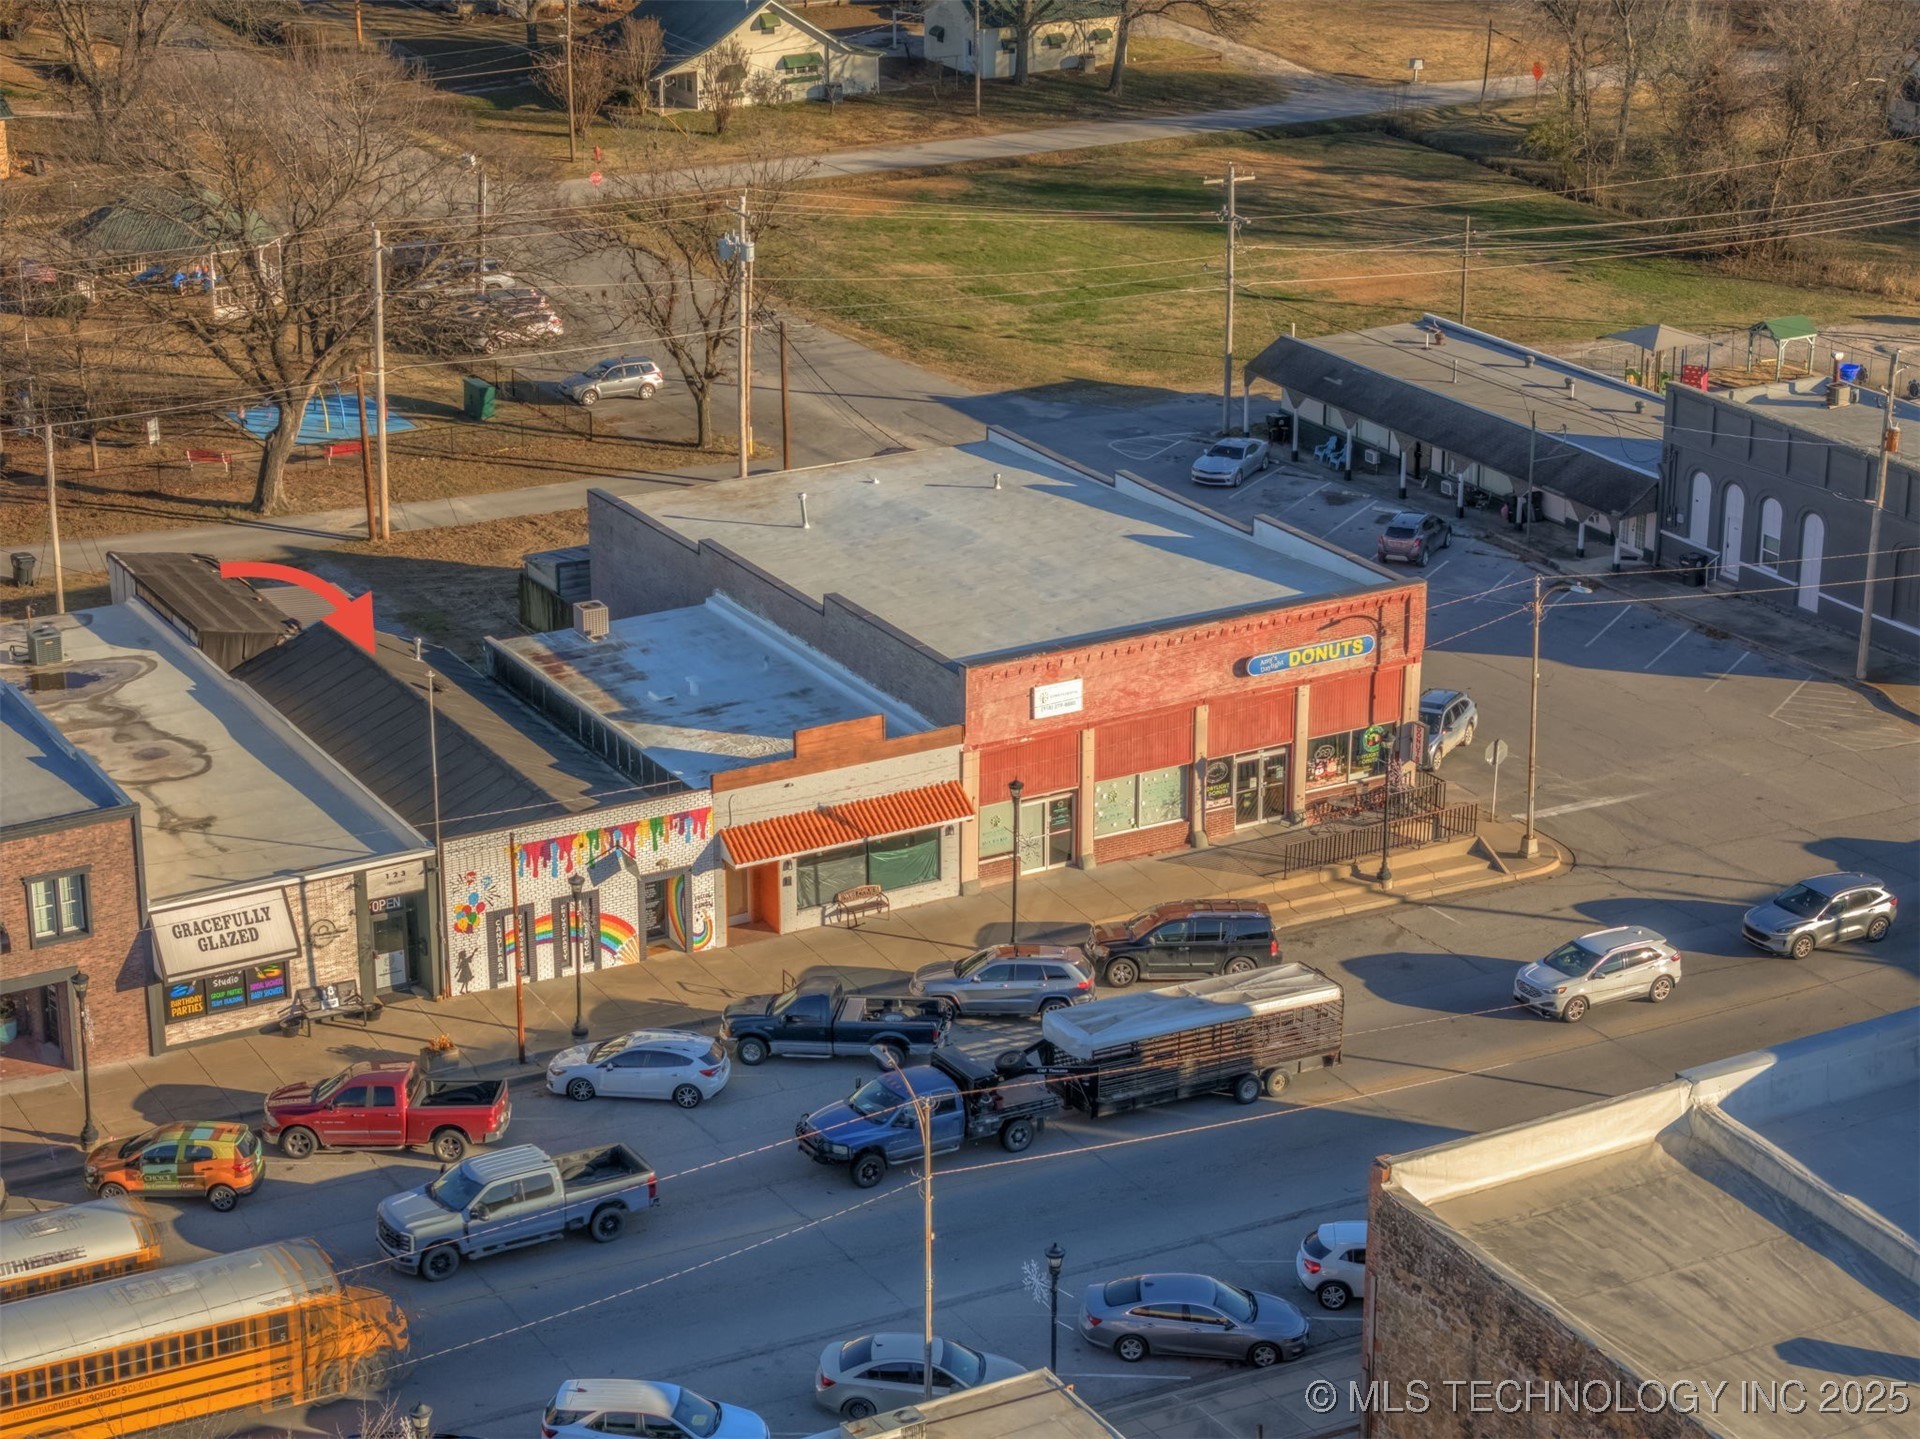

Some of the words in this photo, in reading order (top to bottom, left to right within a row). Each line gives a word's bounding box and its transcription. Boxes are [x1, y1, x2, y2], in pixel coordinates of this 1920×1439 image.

[1288, 638, 1364, 667] DONUTS
[1260, 655, 1278, 666] Amy's
[1260, 660, 1284, 673] Daylight
[371, 896, 401, 912] OPEN
[172, 906, 272, 939] GRACEFULLY
[197, 926, 259, 952] GLAZED
[212, 976, 239, 987] Studio
[210, 991, 226, 1000] GROUP
[263, 986, 284, 998] SHOWERS
[170, 994, 203, 1008] BIRTHDAY
[171, 1002, 203, 1017] PARTIES
